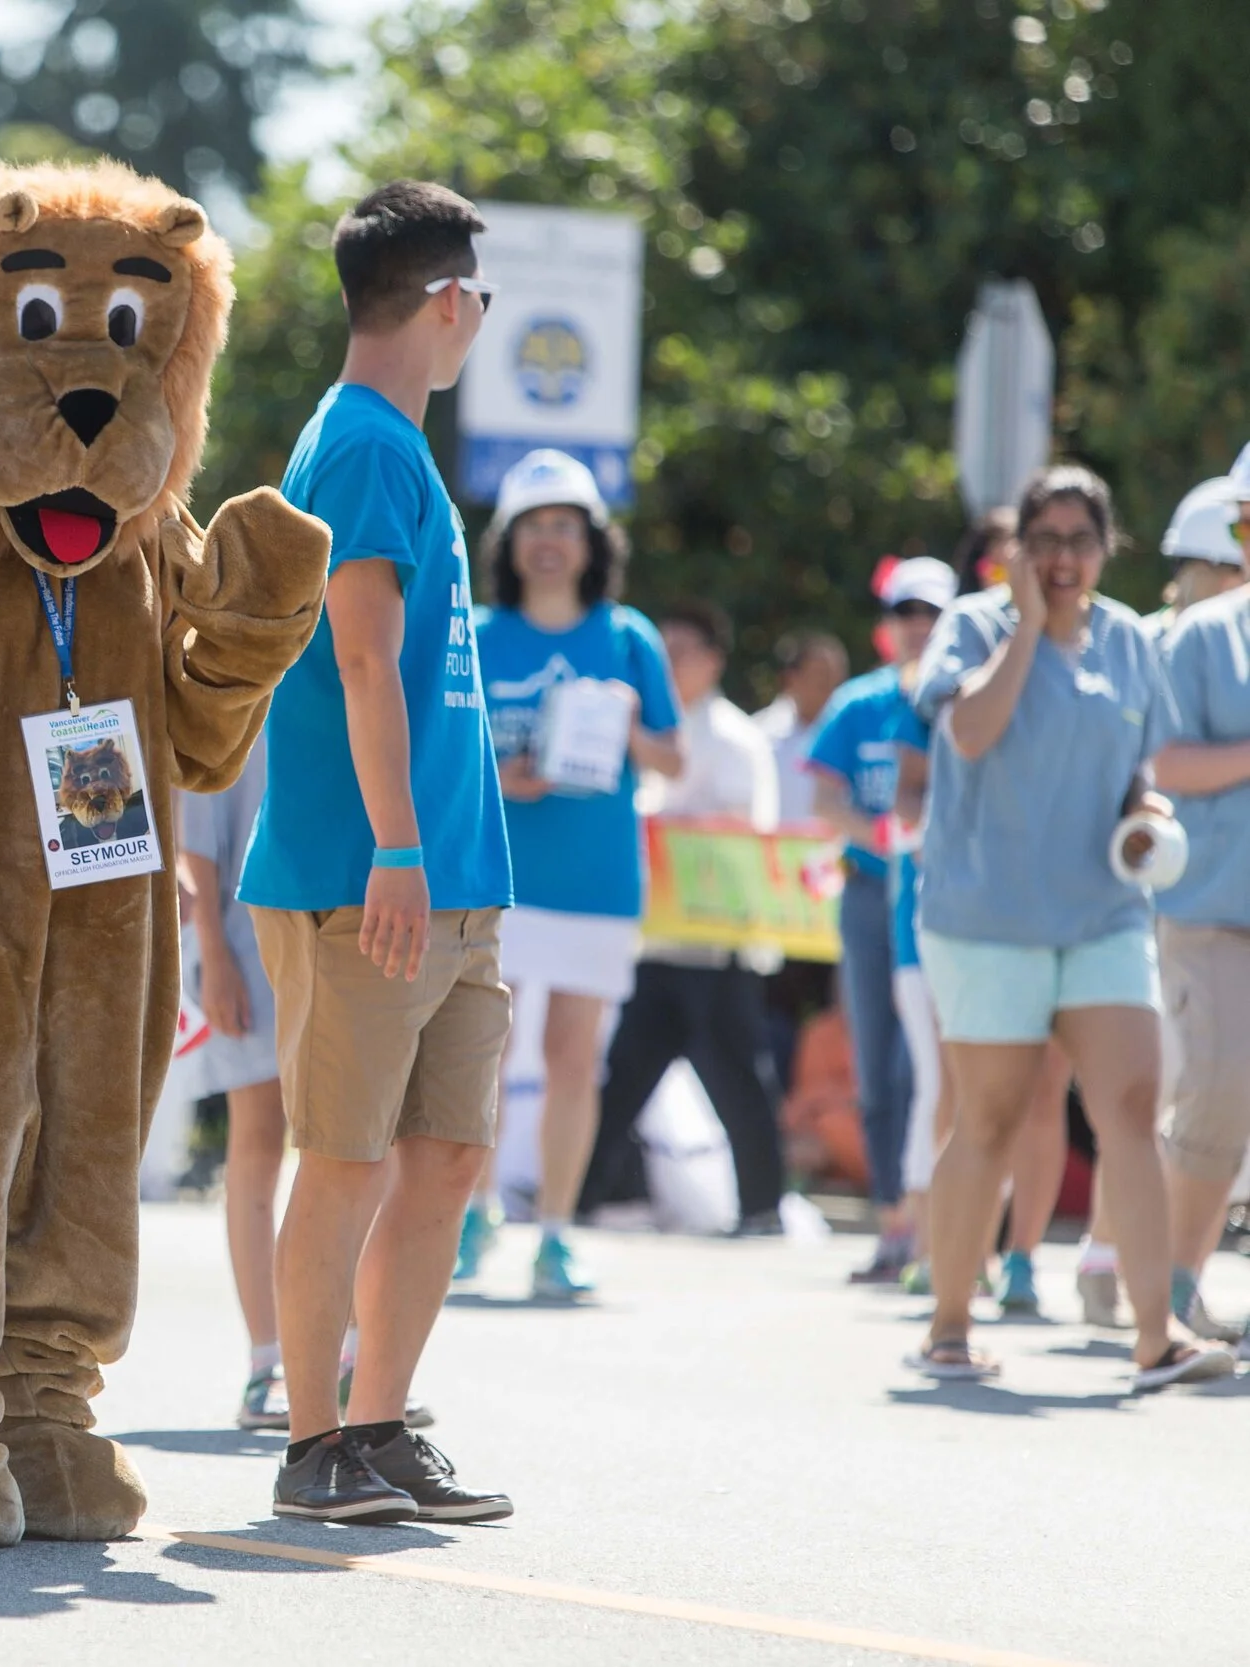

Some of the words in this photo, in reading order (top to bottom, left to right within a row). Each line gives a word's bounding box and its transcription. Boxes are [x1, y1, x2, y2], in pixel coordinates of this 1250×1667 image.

[48, 715, 90, 729] Vancouver
[70, 839, 149, 866] SEYMOUR
[54, 868, 79, 878] OFFICIAL
[92, 859, 129, 870] FOUNDATION
[129, 854, 154, 864] MASCOT
